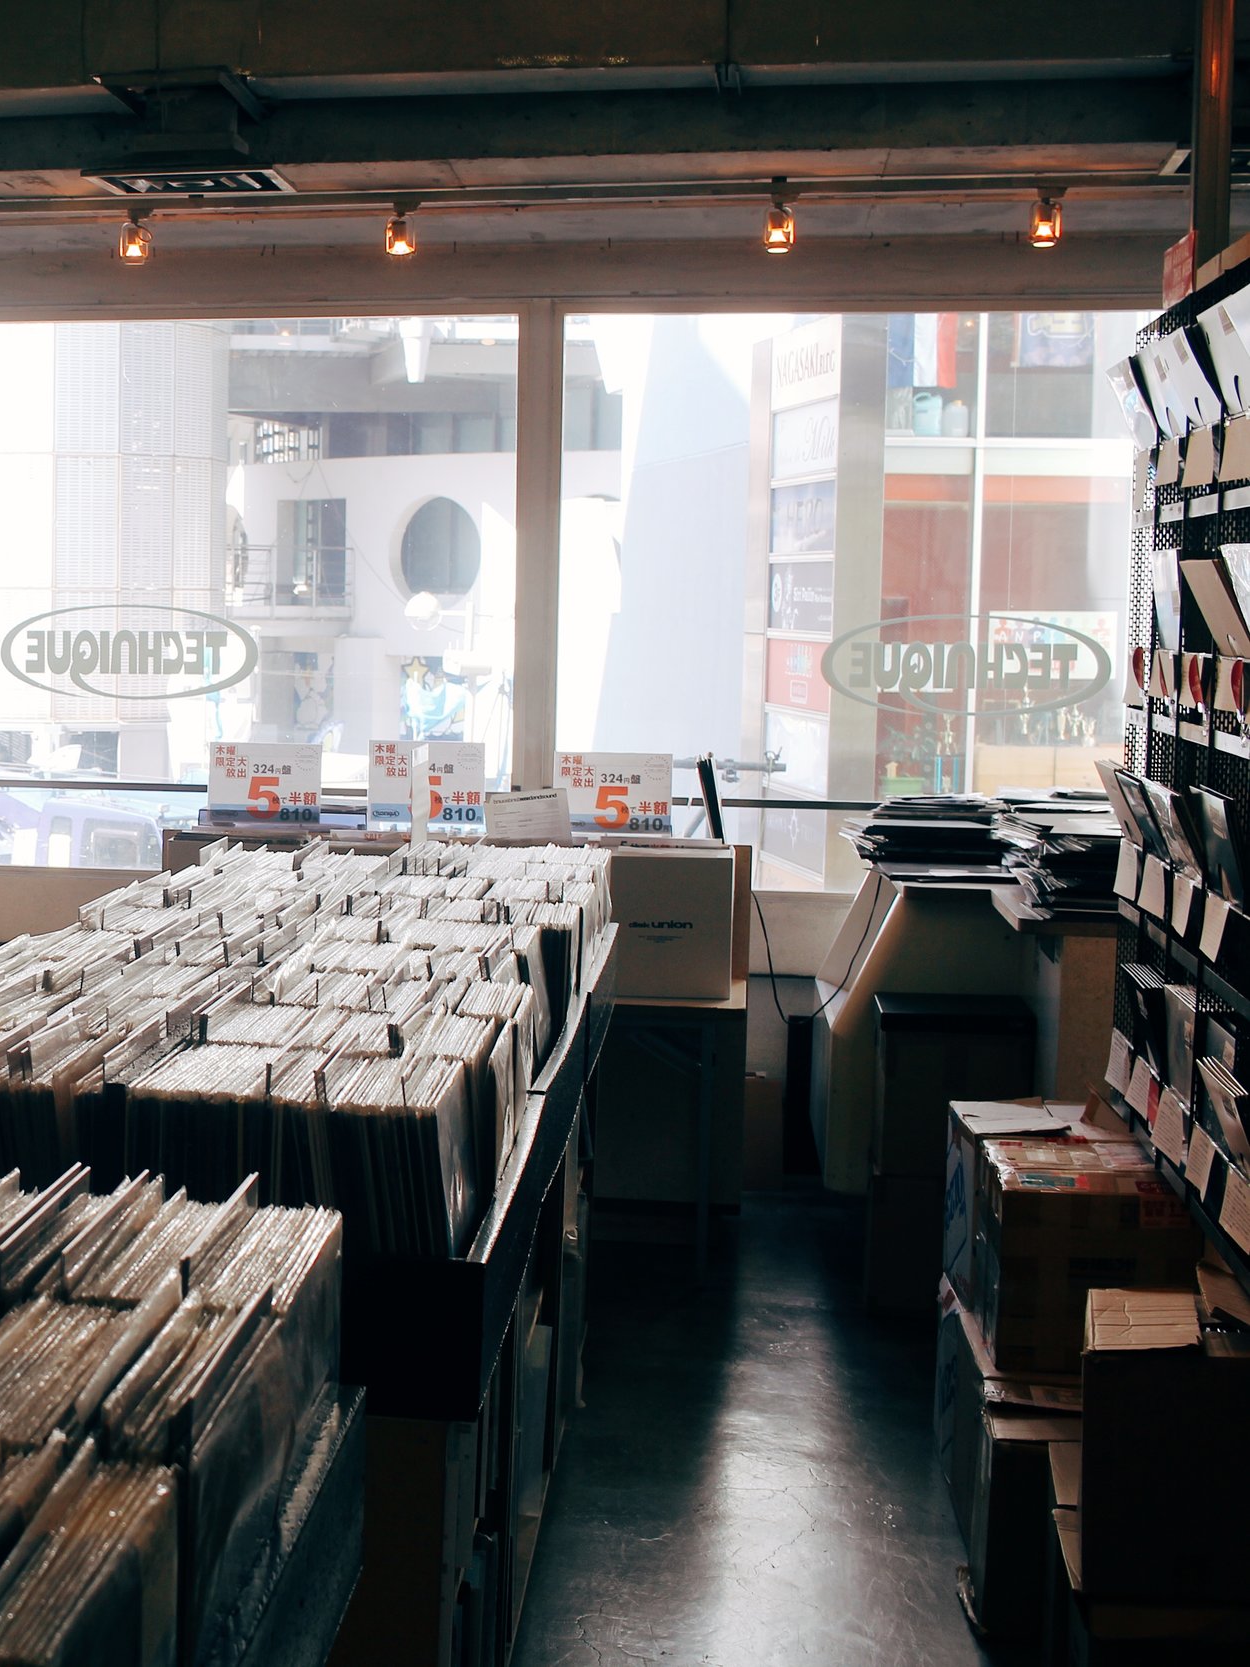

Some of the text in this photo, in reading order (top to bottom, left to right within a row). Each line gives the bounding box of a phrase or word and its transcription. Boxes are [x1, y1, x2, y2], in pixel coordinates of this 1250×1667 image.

[777, 343, 819, 388] NAGASAKI
[215, 745, 237, 756] 木曜
[375, 743, 396, 754] 木曜
[215, 756, 247, 767] 限定大
[375, 755, 407, 766] 限定大
[561, 755, 583, 766] 木曜
[226, 768, 247, 779] 放出
[386, 766, 407, 777] 放出
[561, 766, 595, 777] 限定大
[572, 777, 594, 788] 放出
[651, 920, 693, 929] union
